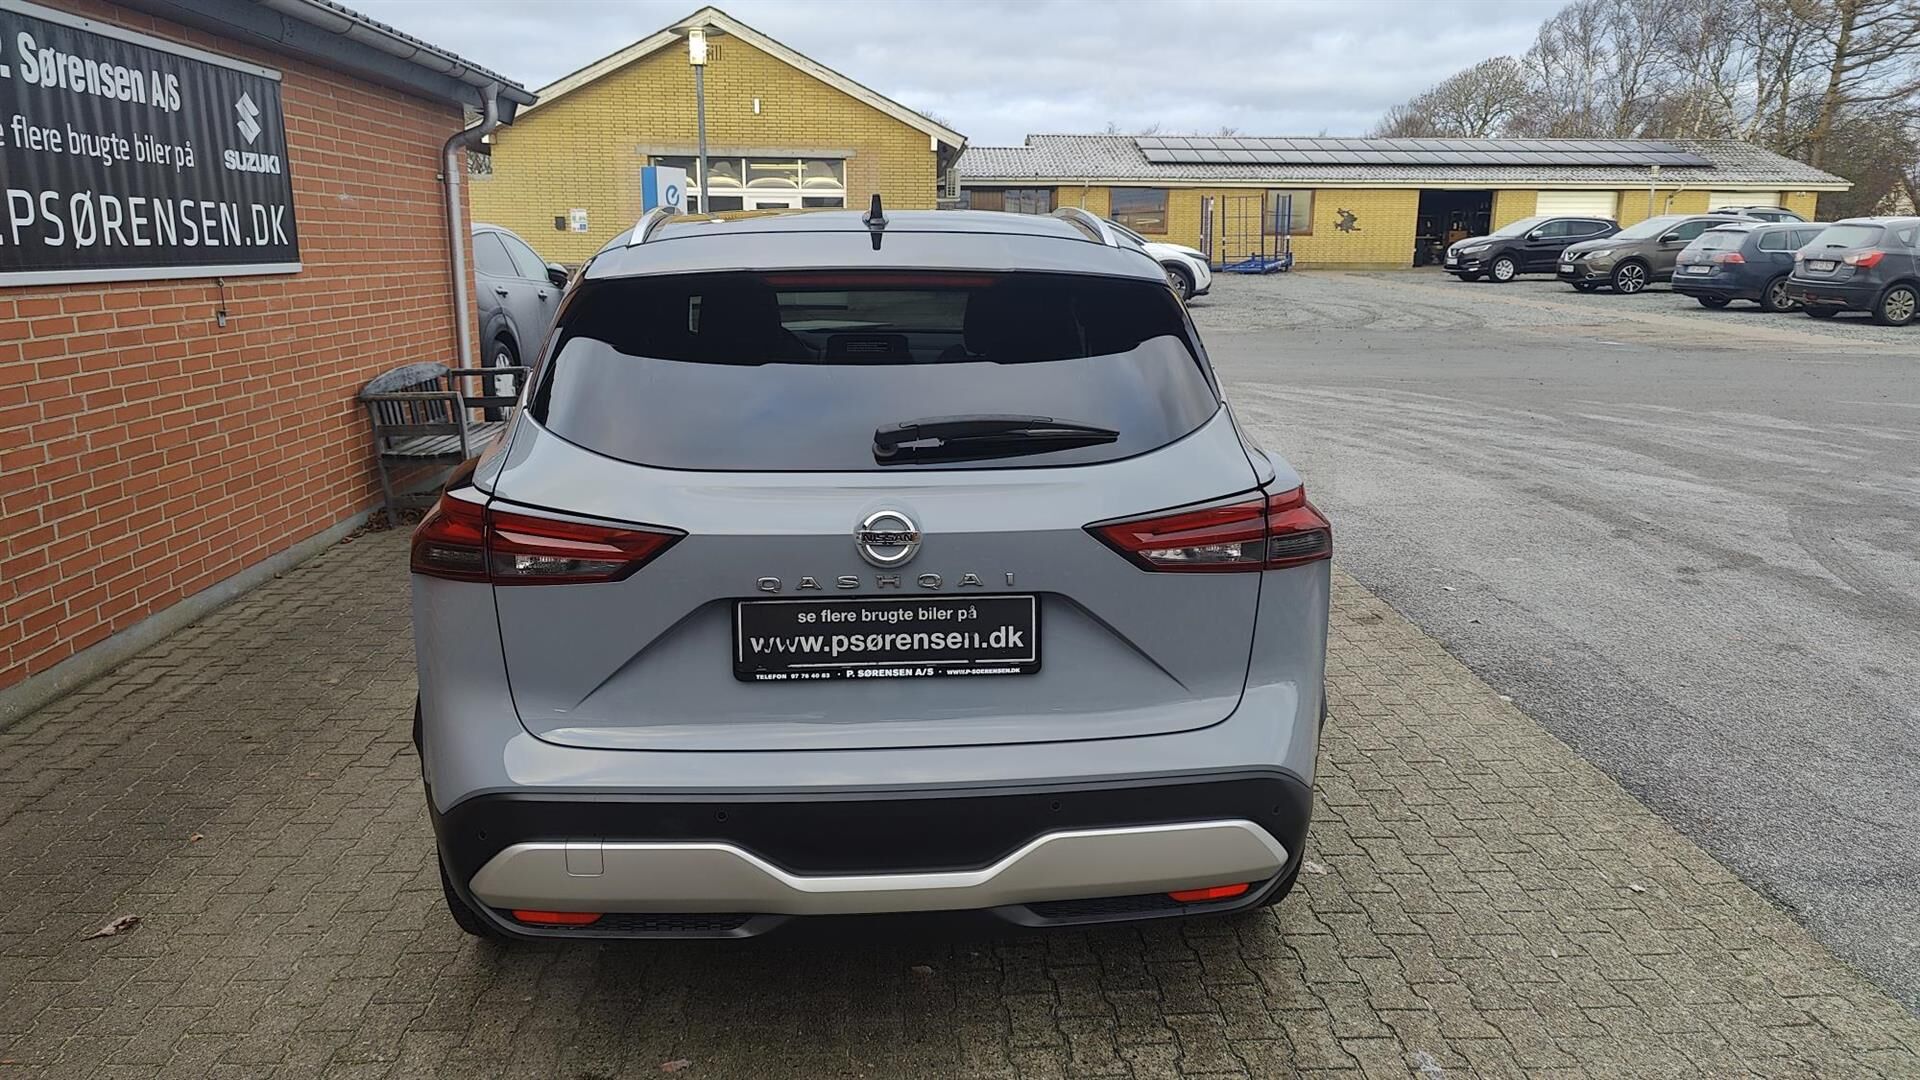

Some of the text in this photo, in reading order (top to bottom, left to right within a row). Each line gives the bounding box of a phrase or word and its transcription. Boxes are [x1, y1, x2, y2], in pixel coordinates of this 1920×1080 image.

[17, 31, 146, 104] Sørensen
[151, 70, 181, 112] A/S
[11, 115, 63, 153] flere
[66, 123, 131, 167] brugte
[133, 133, 172, 164] biler
[174, 141, 195, 173] på
[224, 150, 281, 175] SUZUKI
[862, 532, 913, 543] NISSAN
[757, 572, 1015, 593] QASHQAI
[797, 605, 977, 625] se flere brugte biler på
[750, 626, 1025, 657] www.psørensen.dk
[846, 670, 855, 678] P.
[857, 668, 913, 678] SØRENSEN
[915, 668, 934, 676] A/S
